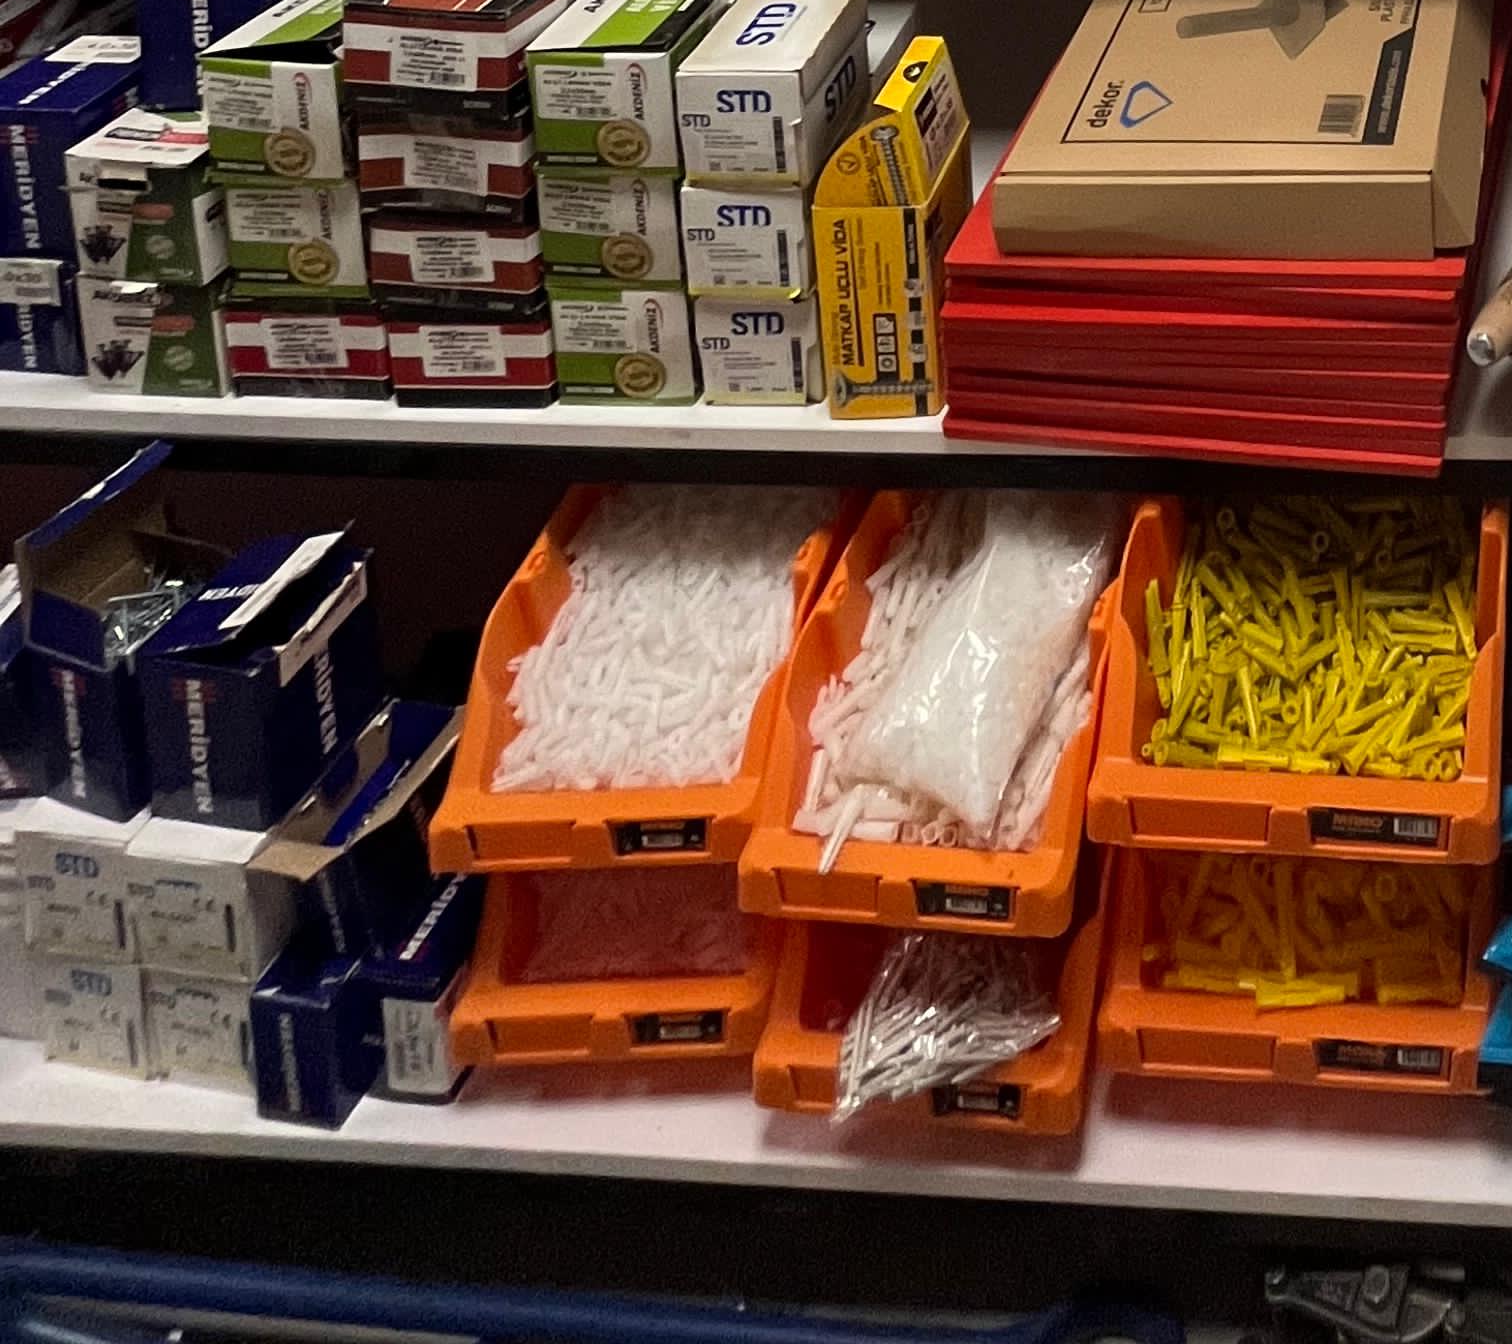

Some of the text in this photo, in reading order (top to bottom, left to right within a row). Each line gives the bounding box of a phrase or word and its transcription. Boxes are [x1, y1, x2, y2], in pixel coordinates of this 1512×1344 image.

[735, 2, 797, 47] STD
[716, 89, 772, 114] STD
[681, 113, 712, 128] STD
[716, 204, 772, 228] STD
[687, 228, 716, 241] STD
[730, 311, 786, 336] STD
[837, 303, 856, 366] MATKAP
[702, 336, 731, 350] STD
[313, 652, 340, 755] RİDYEN
[399, 871, 469, 962] MERİDY
